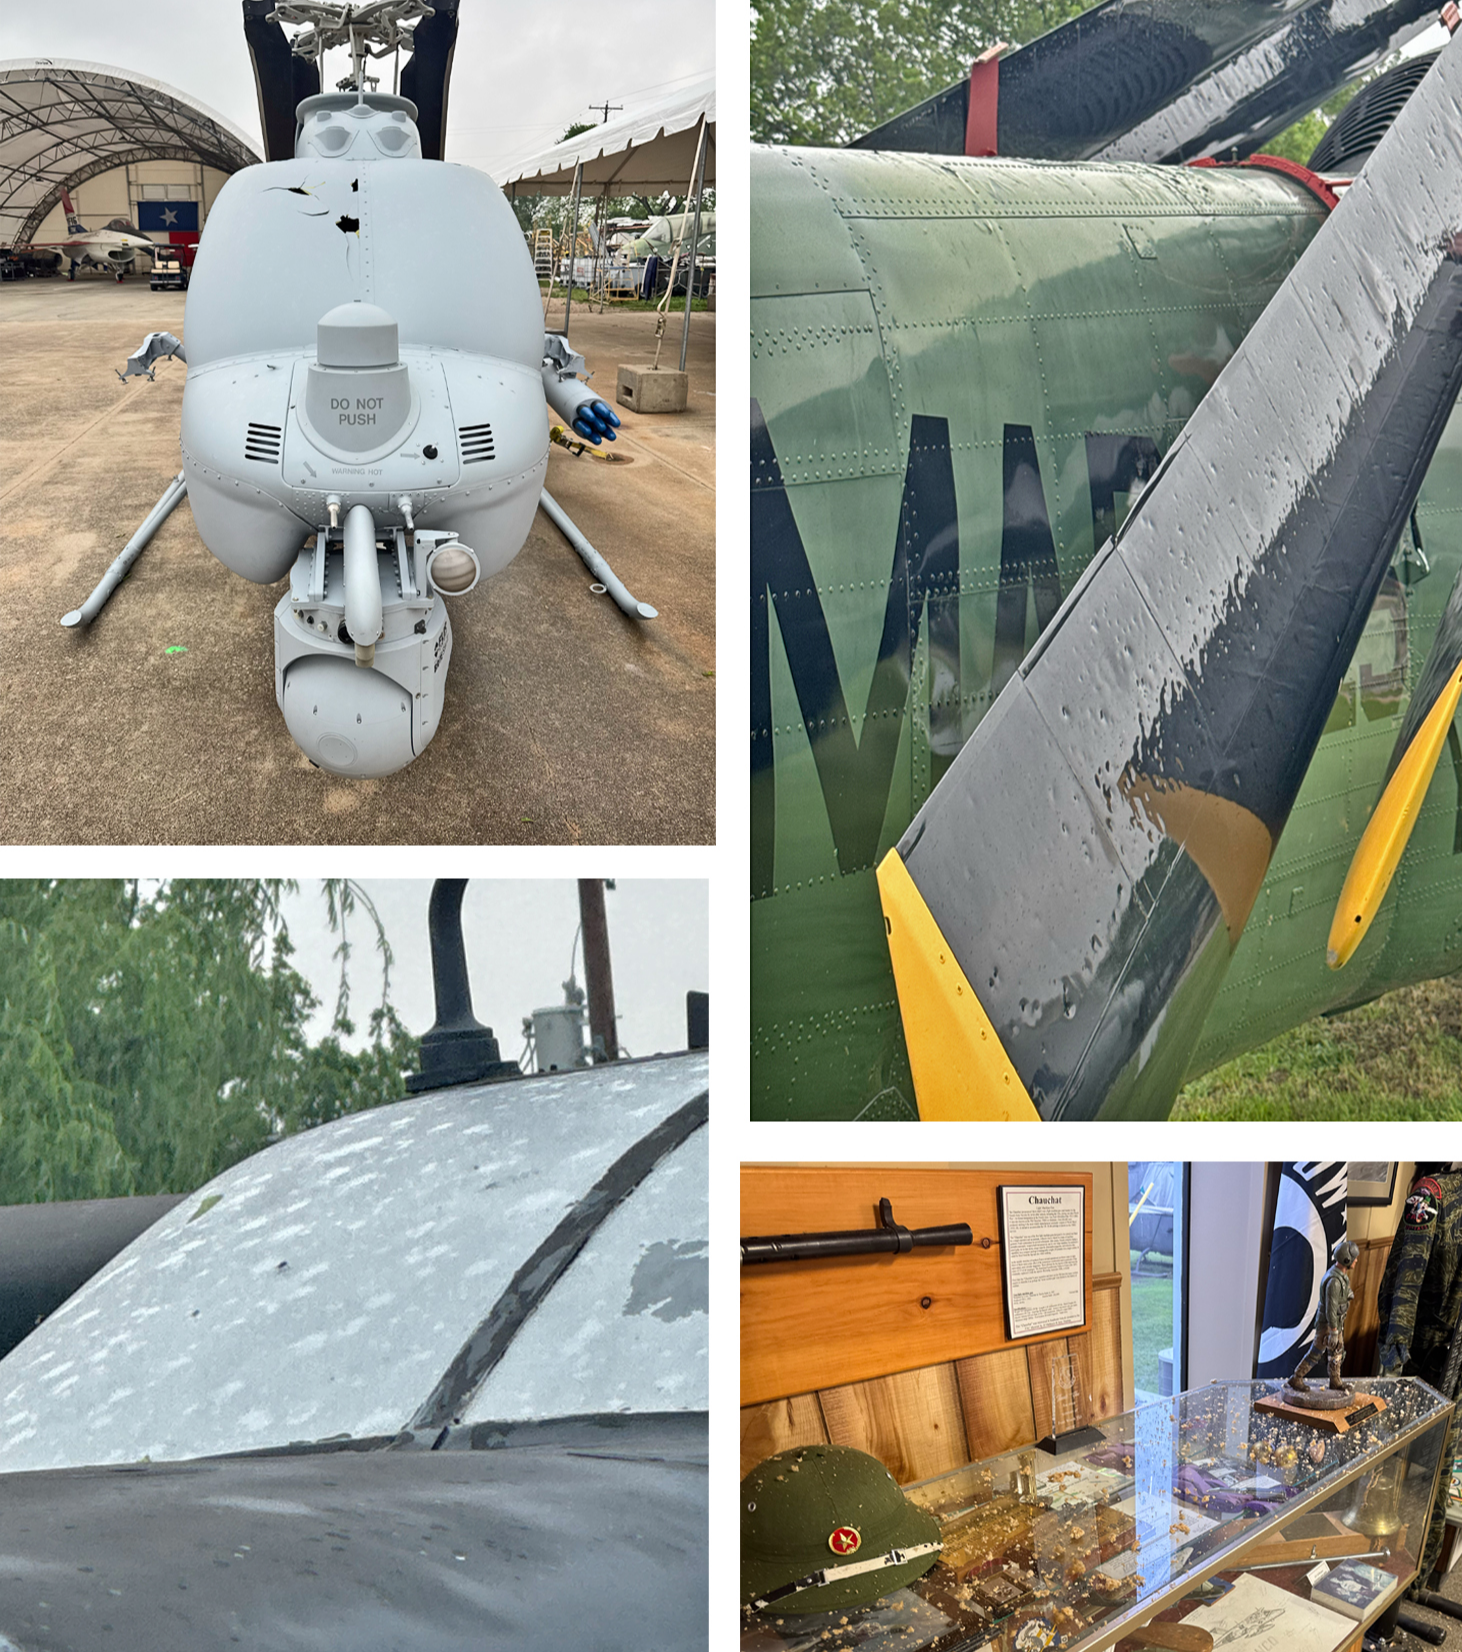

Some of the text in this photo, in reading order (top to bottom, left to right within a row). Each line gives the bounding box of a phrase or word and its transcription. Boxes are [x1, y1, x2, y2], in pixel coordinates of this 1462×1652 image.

[330, 398, 384, 410] DO NOT
[339, 413, 376, 426] PUSH
[331, 467, 383, 476] WARNING HOT
[1028, 1195, 1062, 1205] Chauchat
